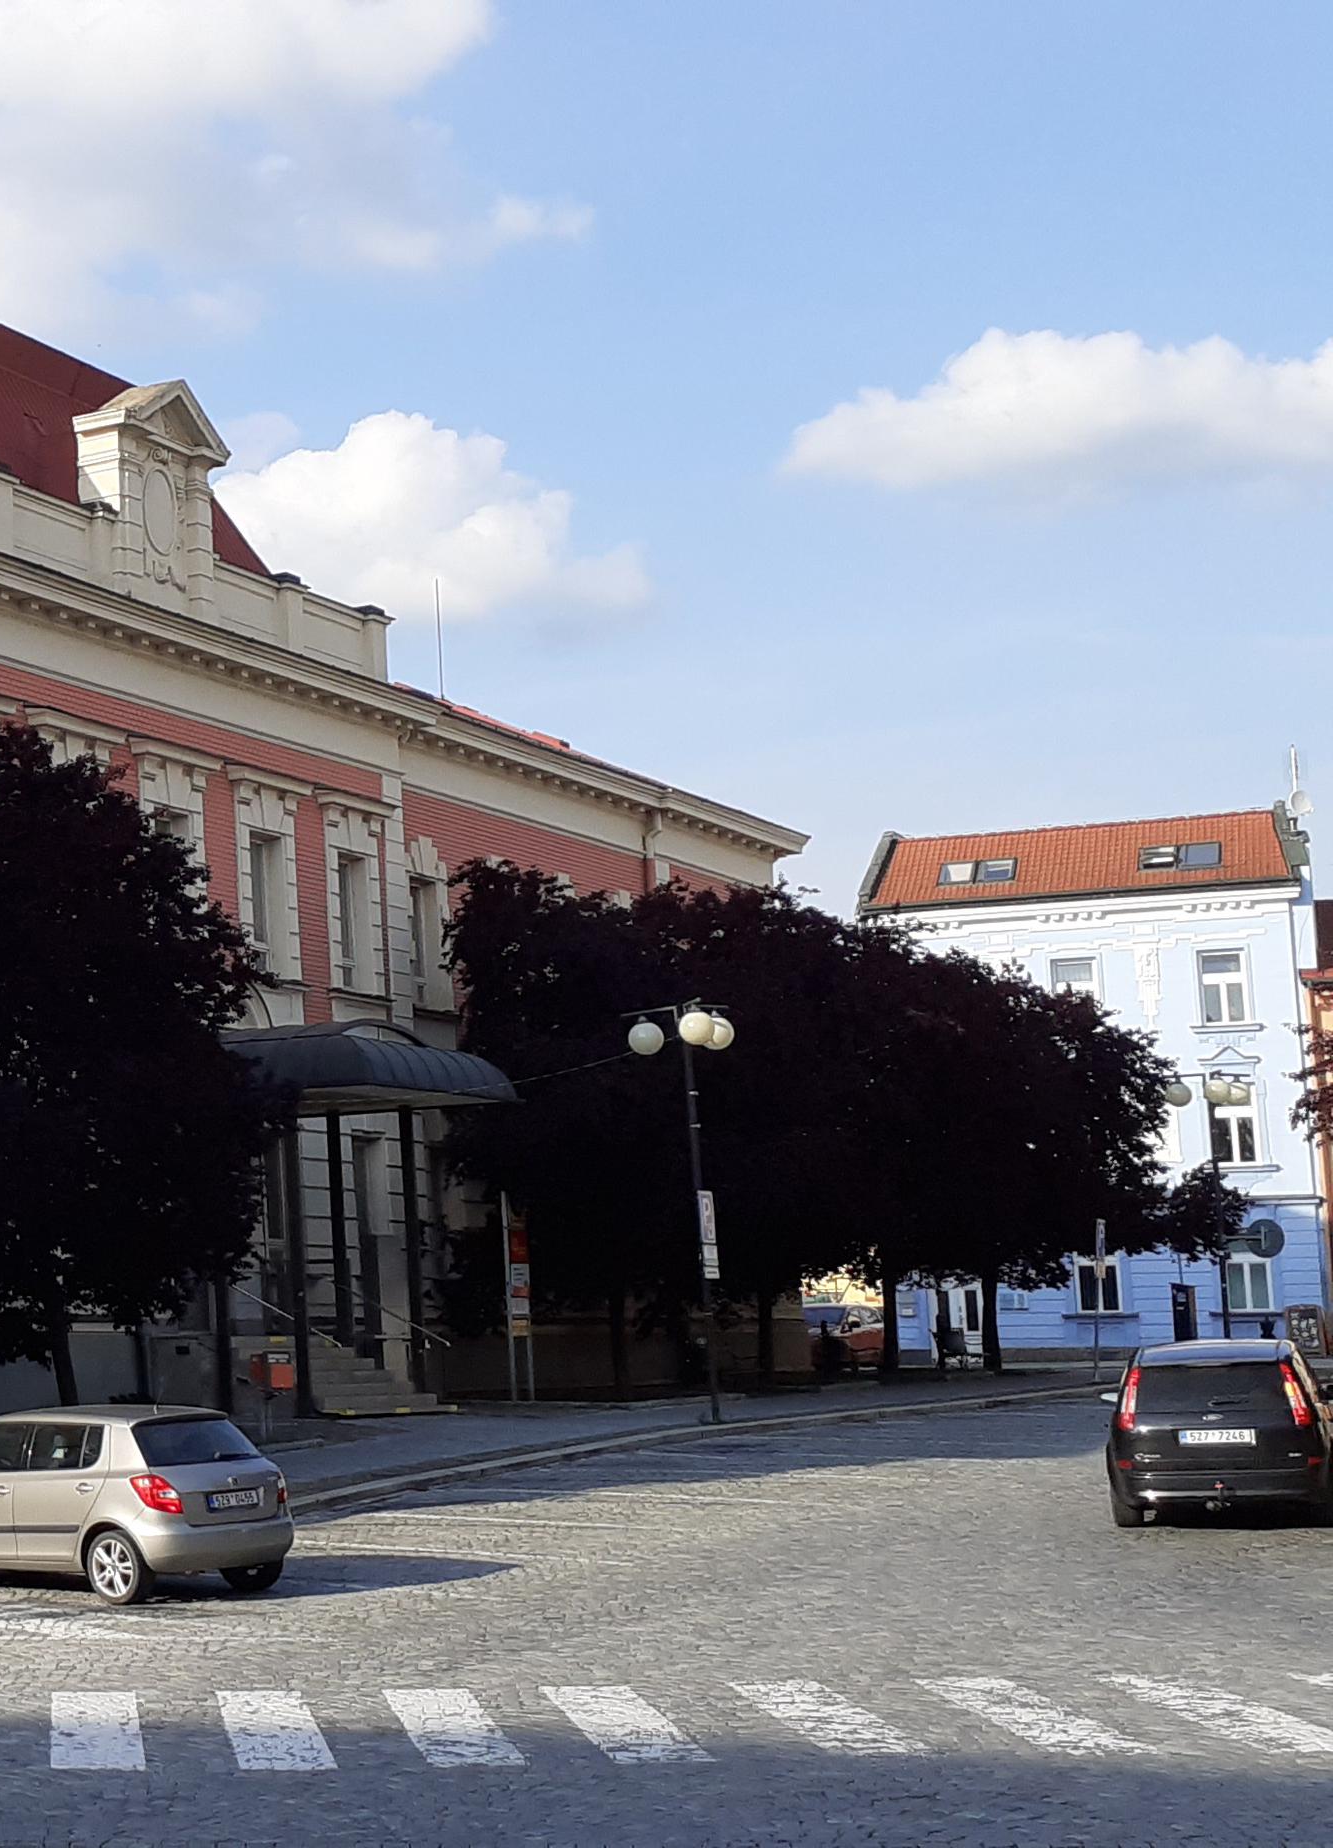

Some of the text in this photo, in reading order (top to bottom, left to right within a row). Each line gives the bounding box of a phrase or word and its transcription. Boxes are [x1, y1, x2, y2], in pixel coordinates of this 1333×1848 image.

[1189, 1430, 1245, 1441] 5Z7 7246
[215, 1495, 231, 1506] 5Z9
